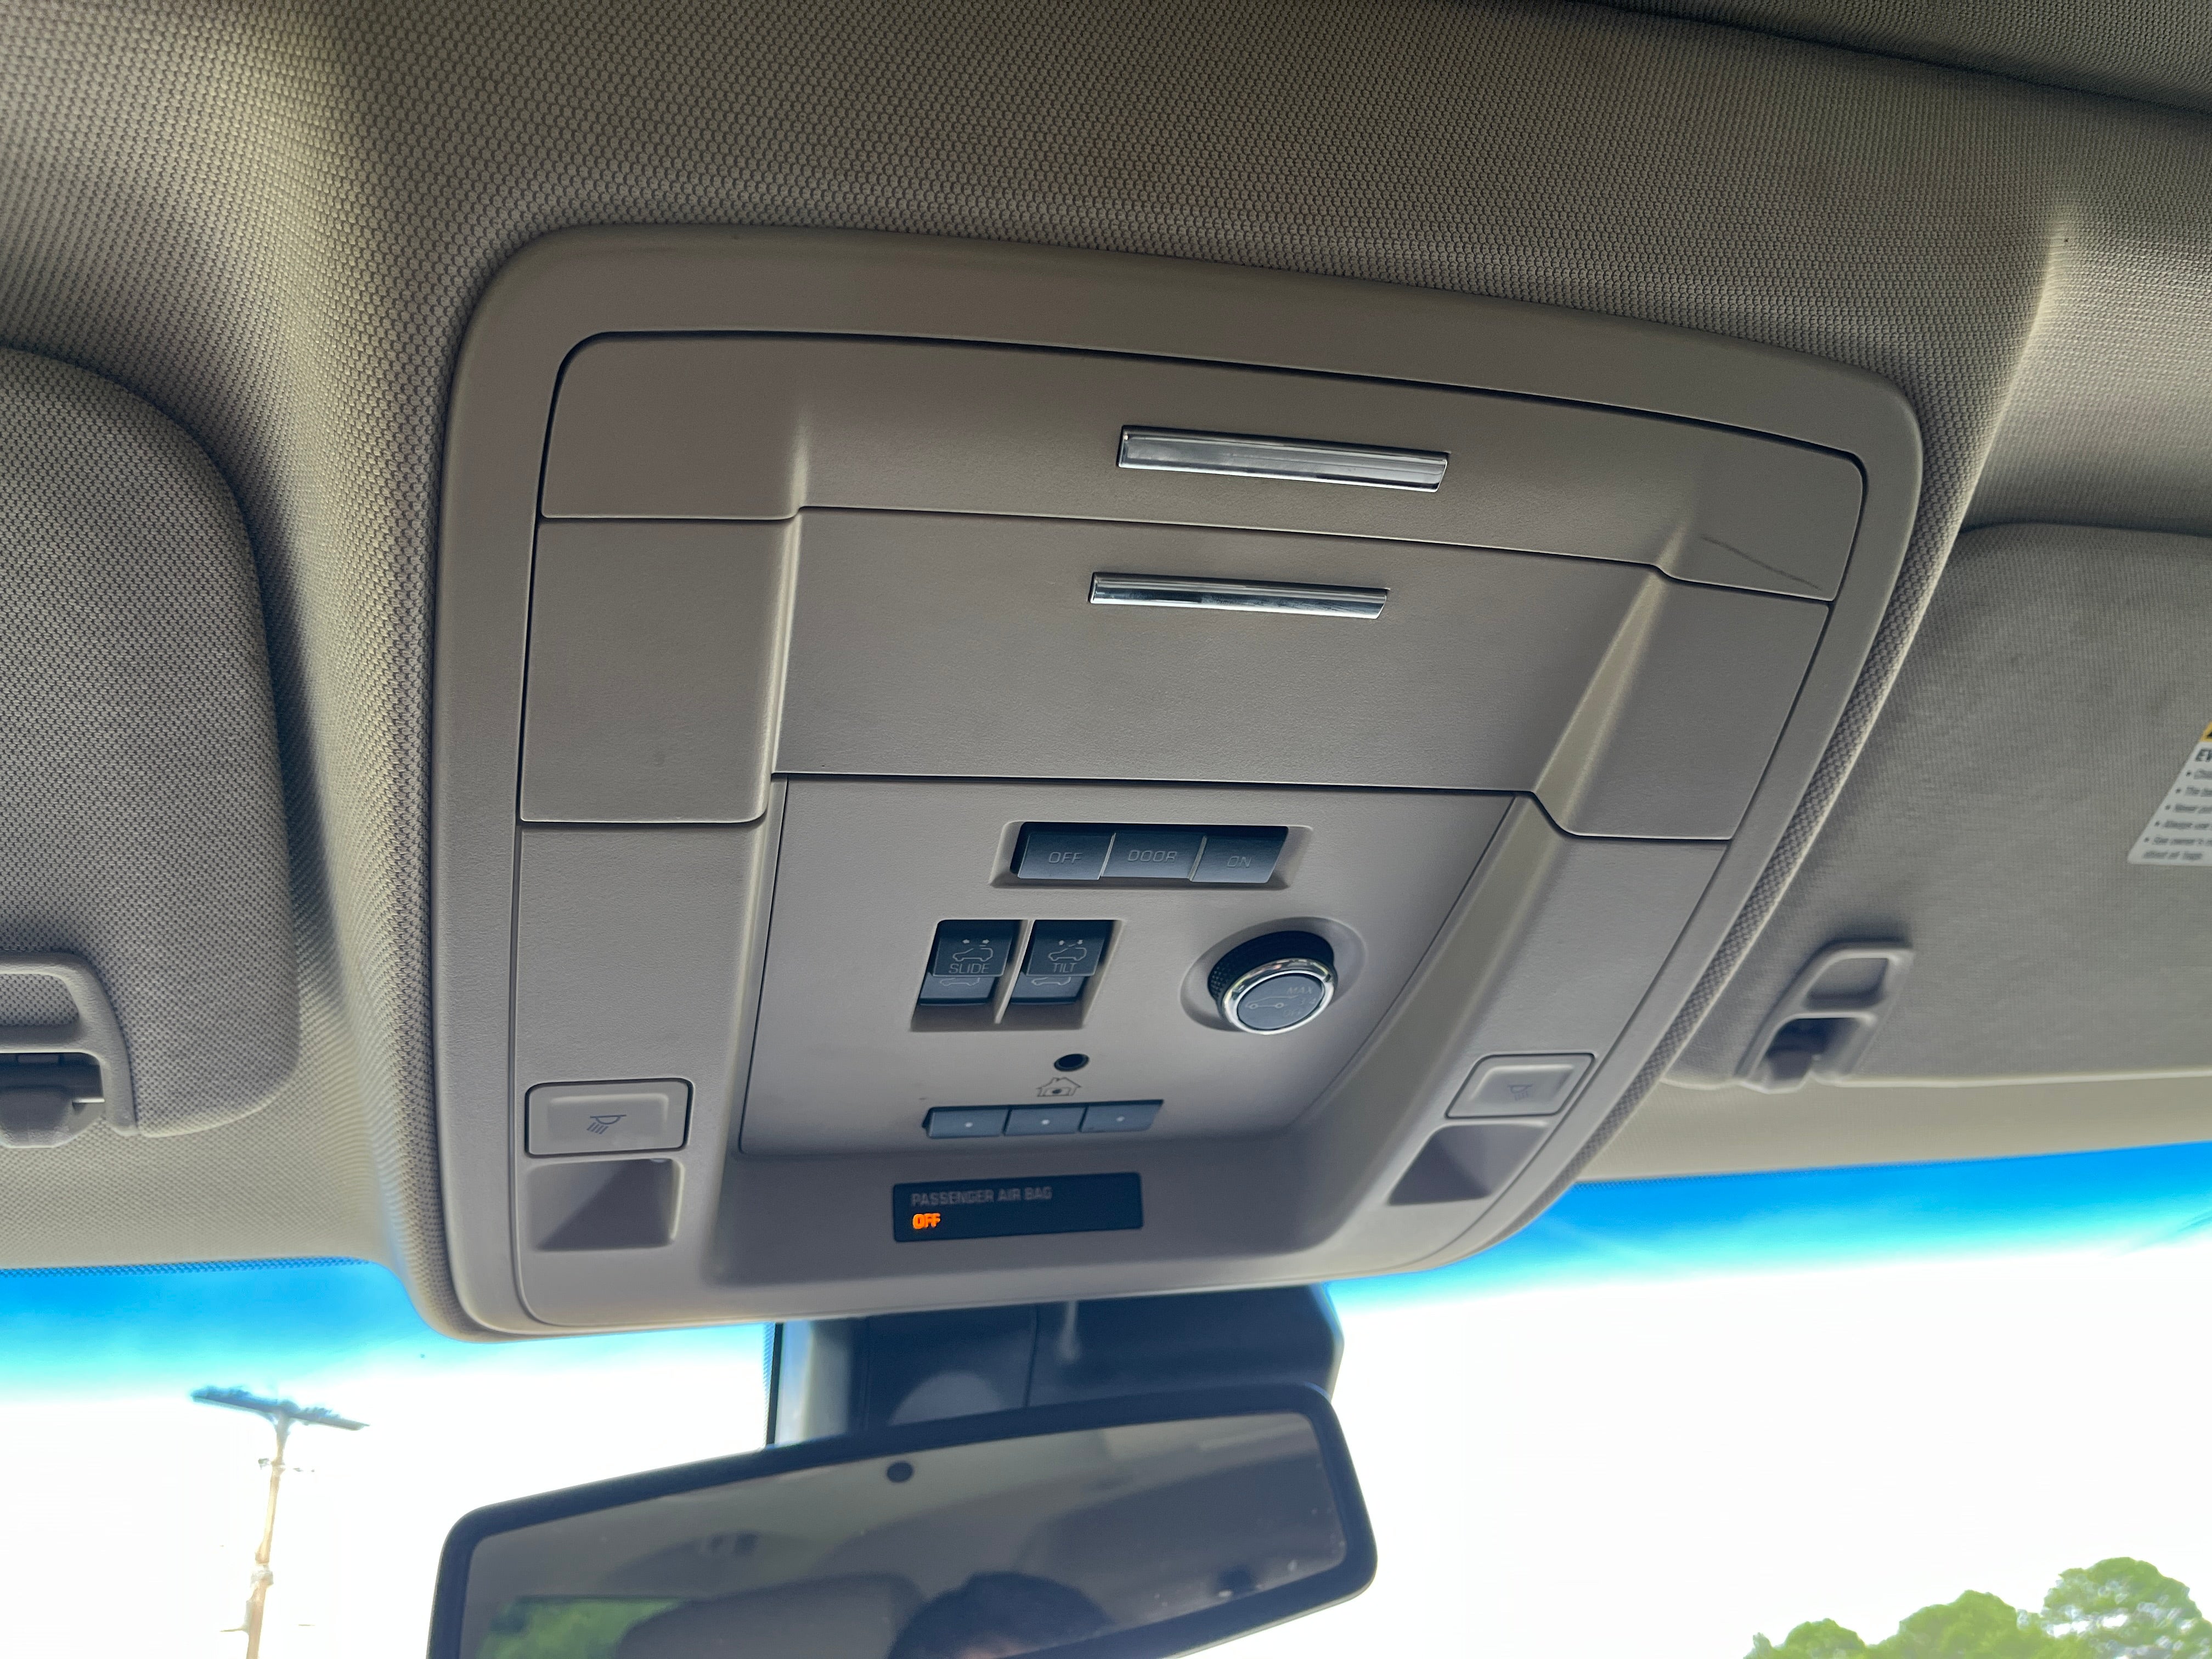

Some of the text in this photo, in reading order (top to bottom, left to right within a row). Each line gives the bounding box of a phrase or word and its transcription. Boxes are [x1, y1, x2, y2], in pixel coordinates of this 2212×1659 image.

[1048, 851, 1083, 864] OFF
[1127, 850, 1178, 862] DOOR
[1227, 855, 1252, 868] ON
[948, 963, 991, 974] SLIDE
[1052, 962, 1078, 973] TILT
[911, 1187, 1052, 1206] PASSENGER AIR BAG
[913, 1213, 941, 1229] OFF
